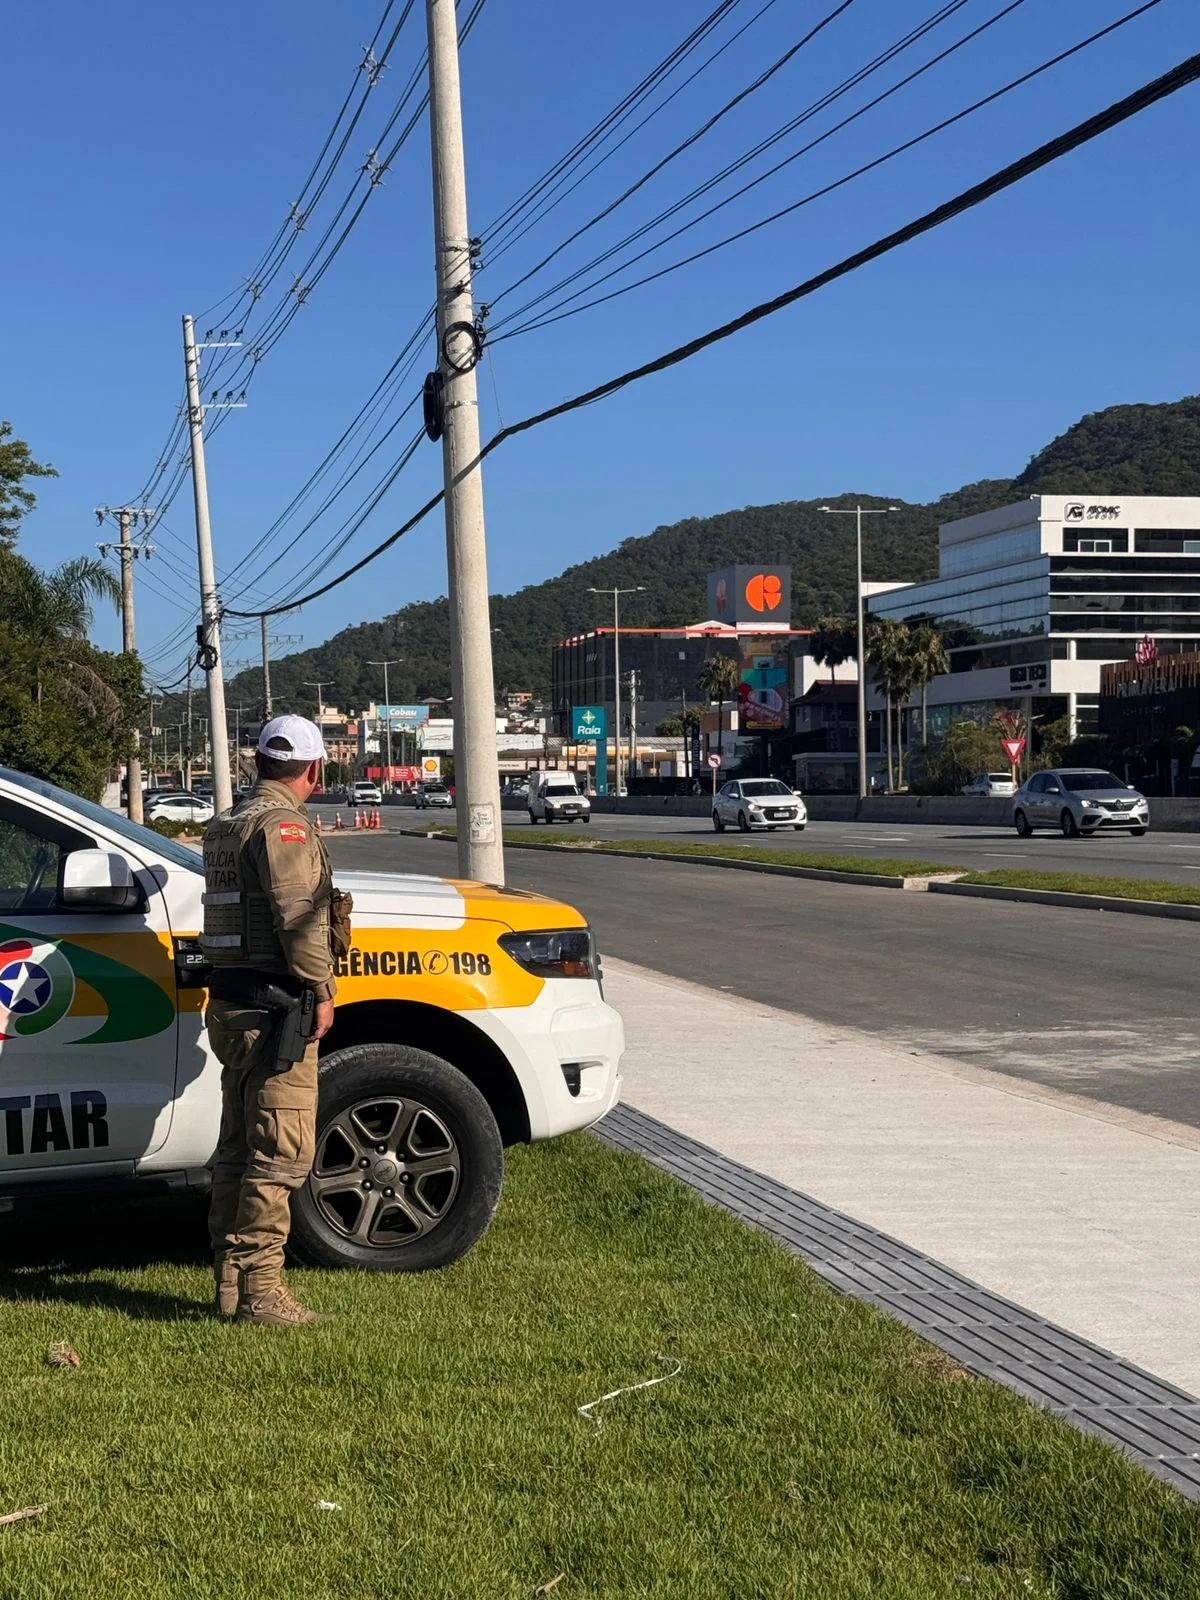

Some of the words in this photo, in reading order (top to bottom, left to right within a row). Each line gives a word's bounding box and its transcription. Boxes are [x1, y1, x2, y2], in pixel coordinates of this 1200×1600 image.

[1116, 677, 1176, 699] PRIMAVERA
[390, 708, 417, 716] Cobasi
[577, 725, 601, 735] Raia
[449, 952, 491, 976] 198
[0, 1090, 109, 1155] TAR
